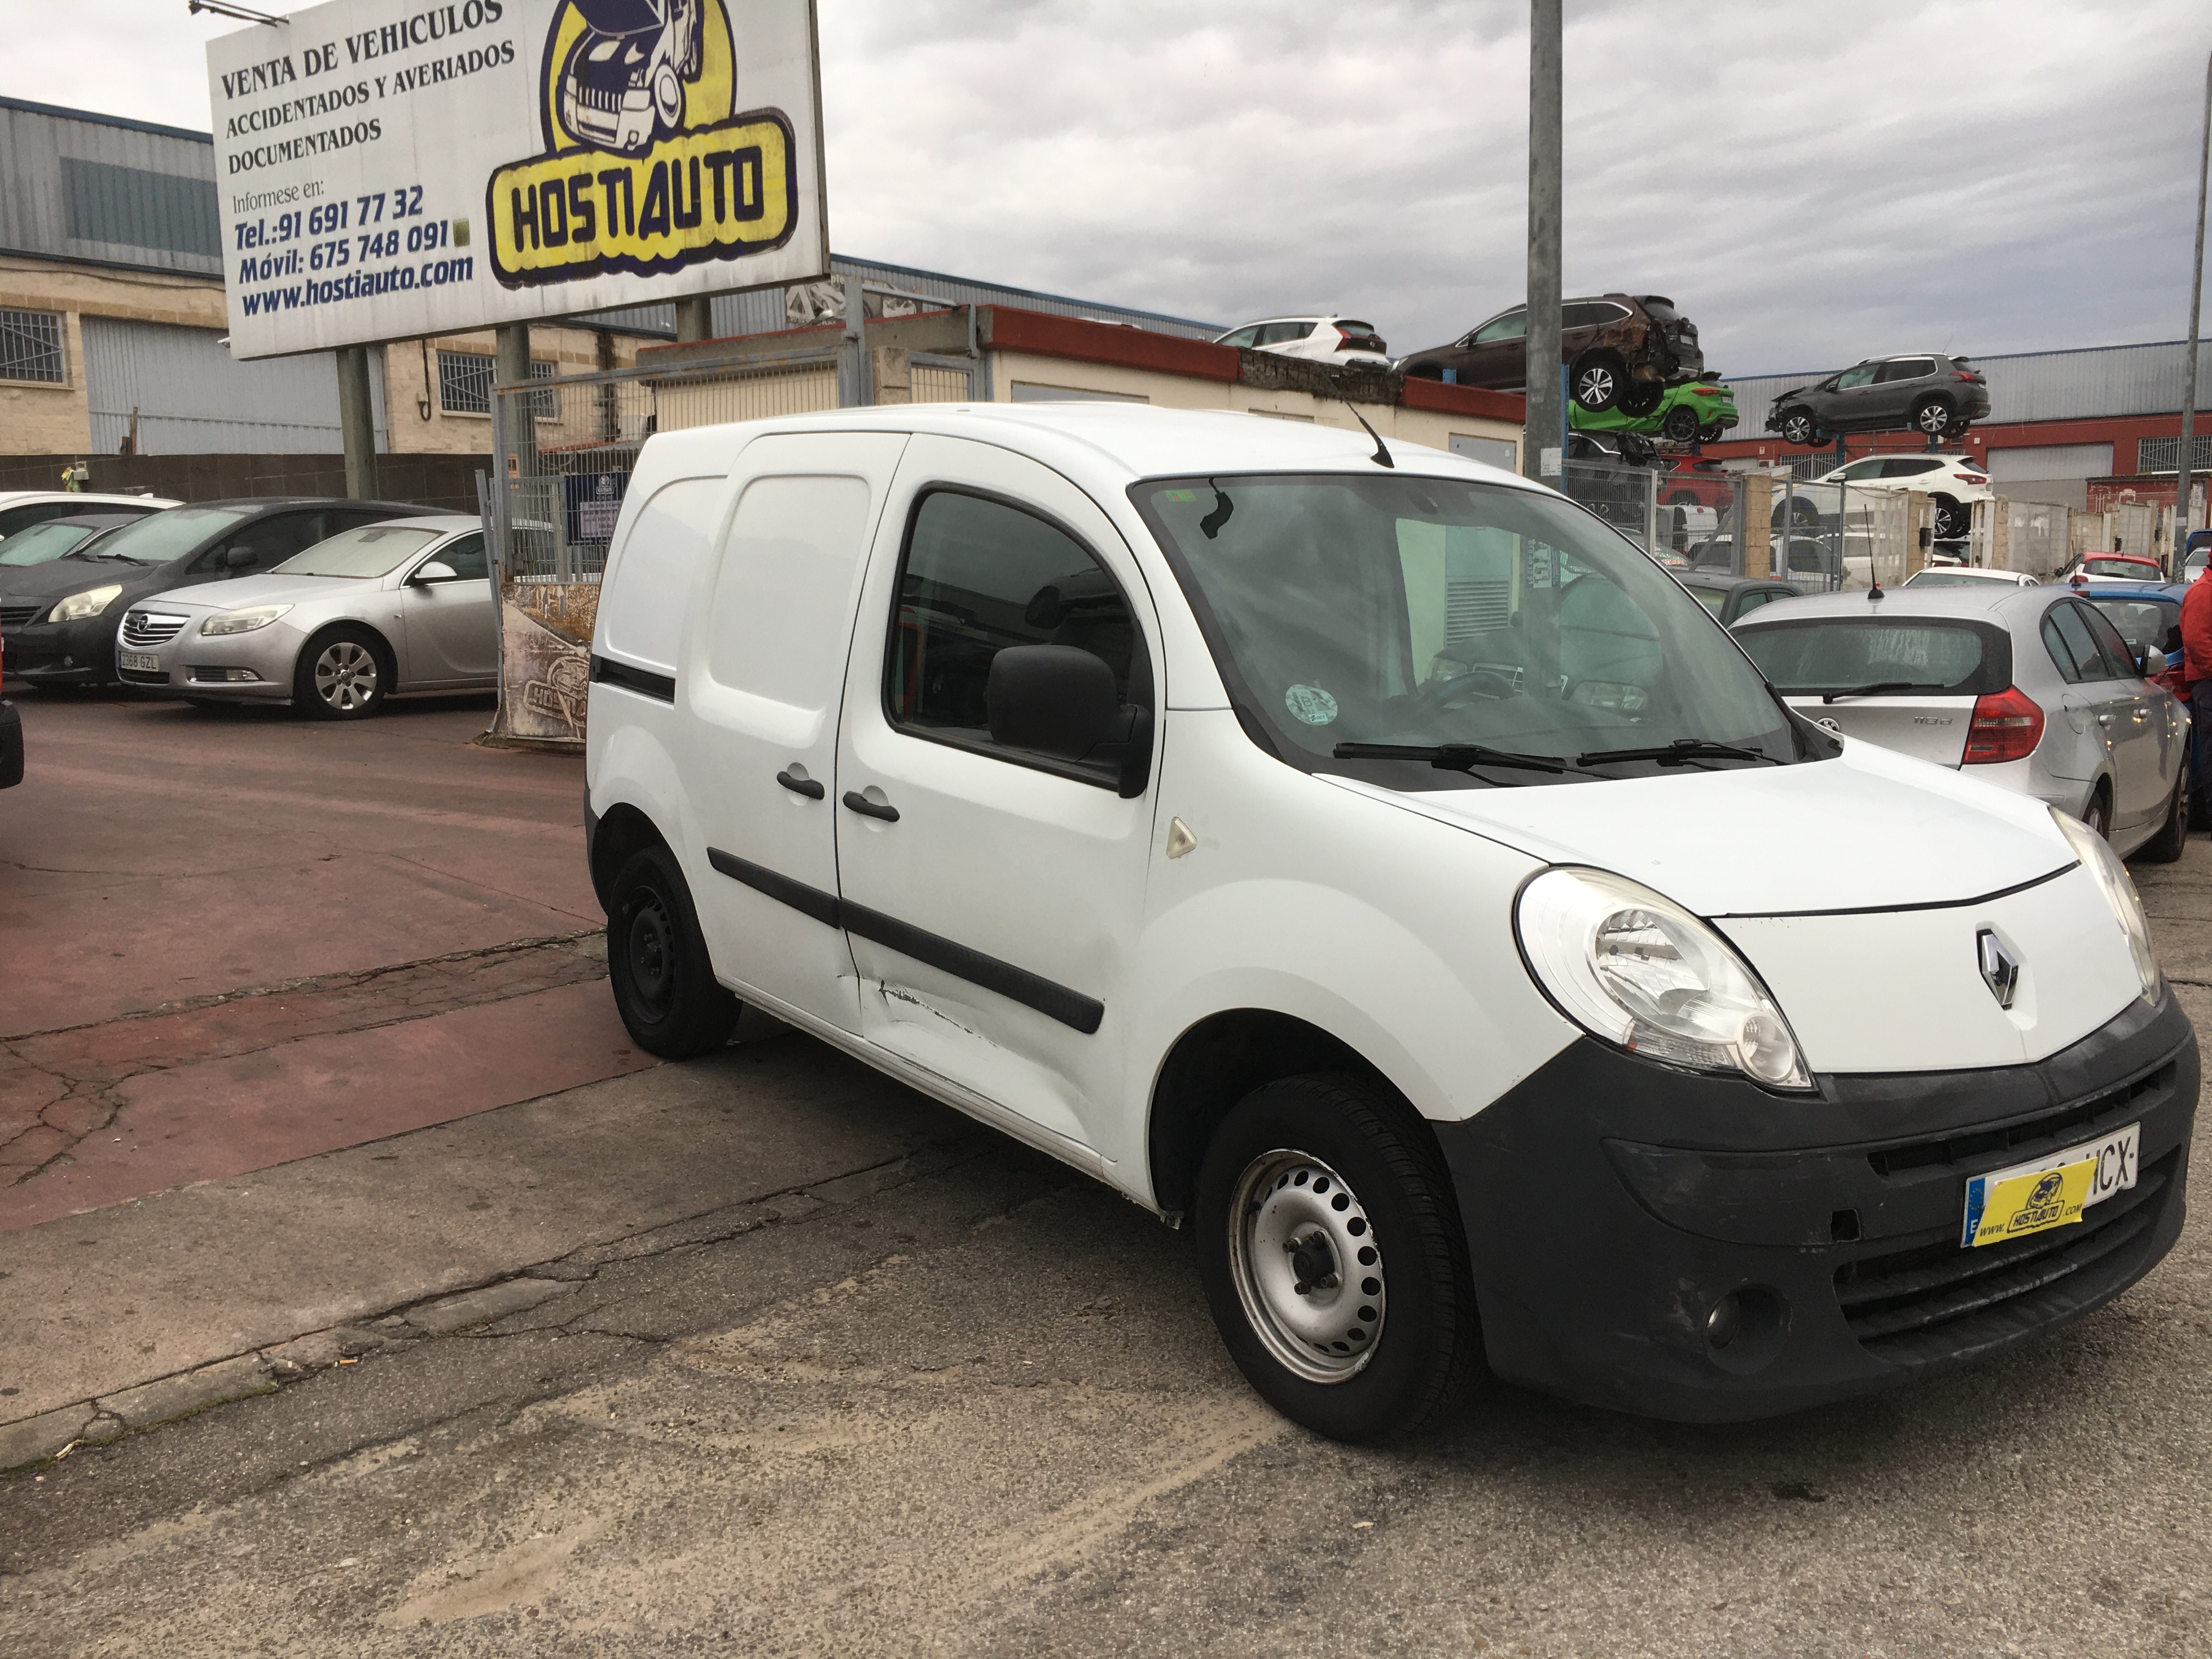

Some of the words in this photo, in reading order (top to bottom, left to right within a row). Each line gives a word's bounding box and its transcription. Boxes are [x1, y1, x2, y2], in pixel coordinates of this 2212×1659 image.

[221, 55, 296, 100] VENTA
[303, 42, 339, 78] DE
[345, 0, 503, 64] VEHICULOS
[226, 81, 370, 139] ACCIDENTADOS
[374, 76, 387, 98] Y
[393, 40, 515, 95] AVERIADOS
[228, 119, 381, 175] DOCUMENTADOS
[233, 185, 300, 214] Informese
[303, 180, 325, 199] en:
[309, 201, 348, 236] 691
[357, 193, 386, 225] 77
[393, 185, 424, 219] 32
[511, 145, 764, 253] HOSTIAUTO
[239, 252, 304, 284] Móvil:
[310, 239, 349, 271] 675
[357, 230, 399, 263] 748
[408, 219, 448, 252] 091
[242, 256, 473, 317] www.hostiauto.com
[140, 656, 157, 669] GZL
